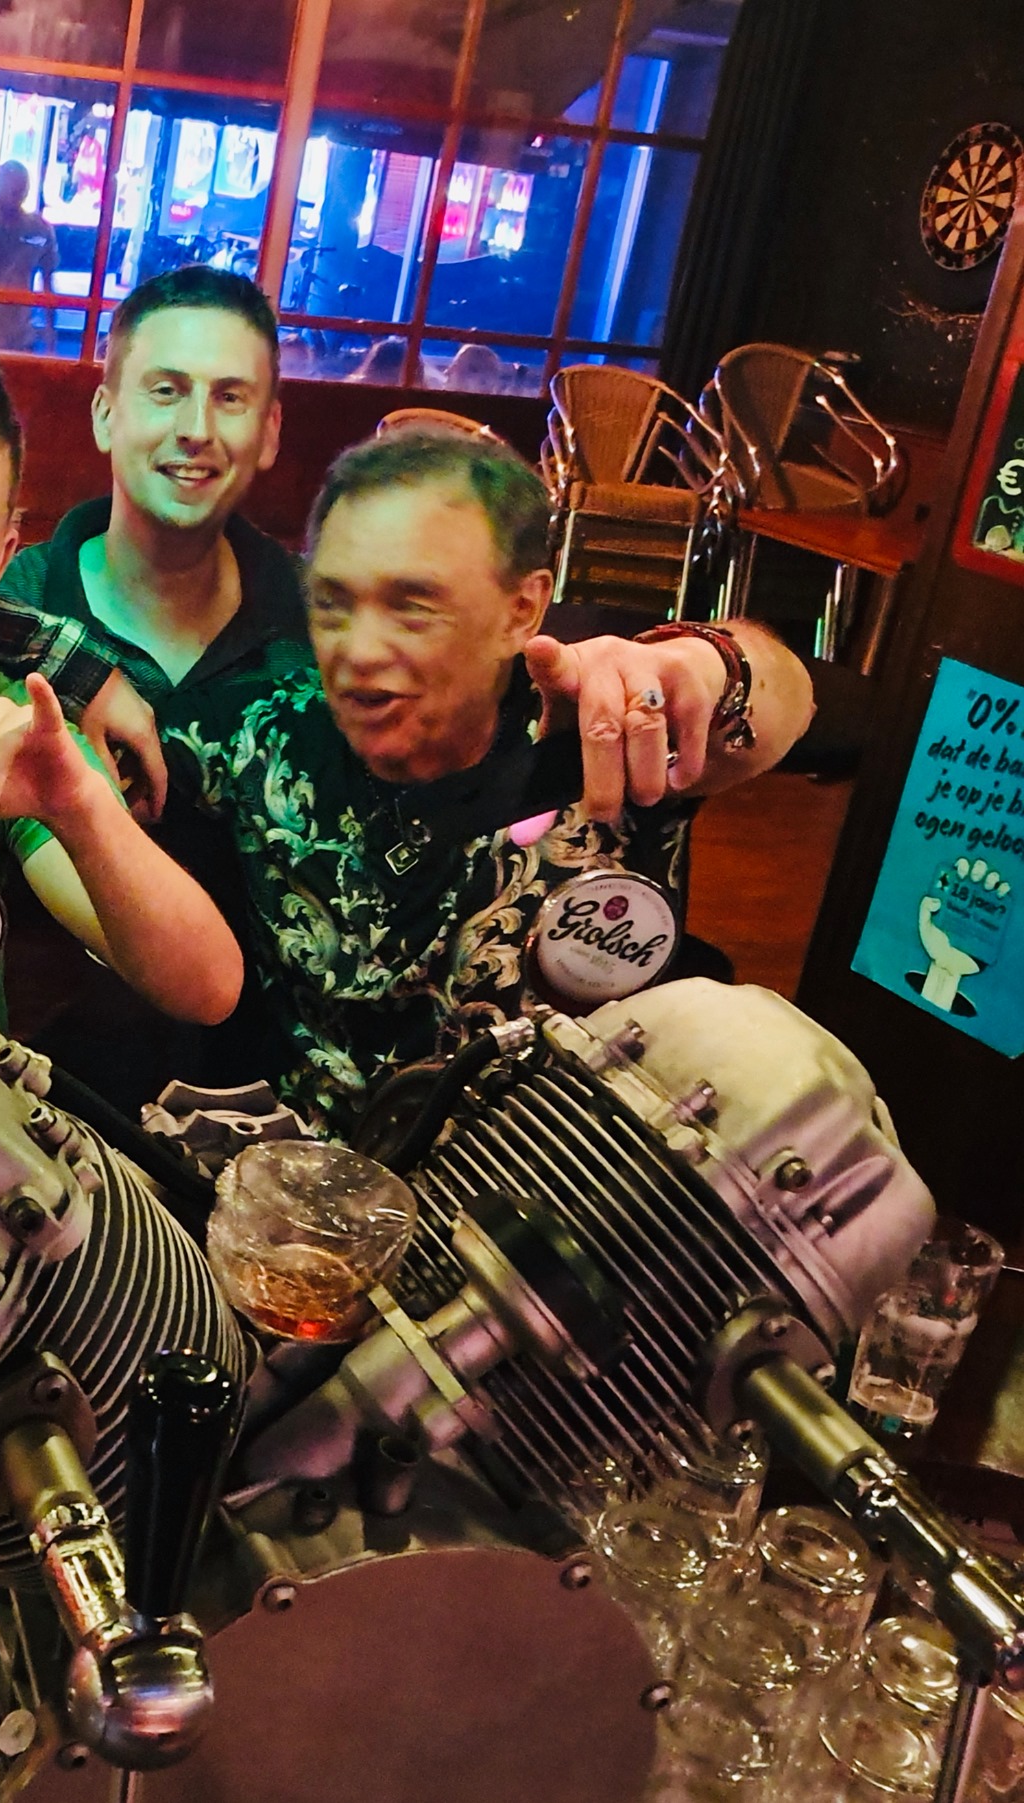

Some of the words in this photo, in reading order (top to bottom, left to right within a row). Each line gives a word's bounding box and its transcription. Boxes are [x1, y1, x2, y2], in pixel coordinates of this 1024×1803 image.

[967, 689, 1024, 741] "0%
[928, 735, 967, 763] dat
[965, 744, 991, 770] de
[994, 746, 1024, 779] ba
[926, 768, 952, 803] je
[956, 785, 982, 811] op
[976, 781, 1004, 816] je
[1006, 788, 1024, 817] b
[915, 811, 966, 841] ogen
[967, 822, 1024, 862] geloo
[547, 896, 668, 968] Grolsch
